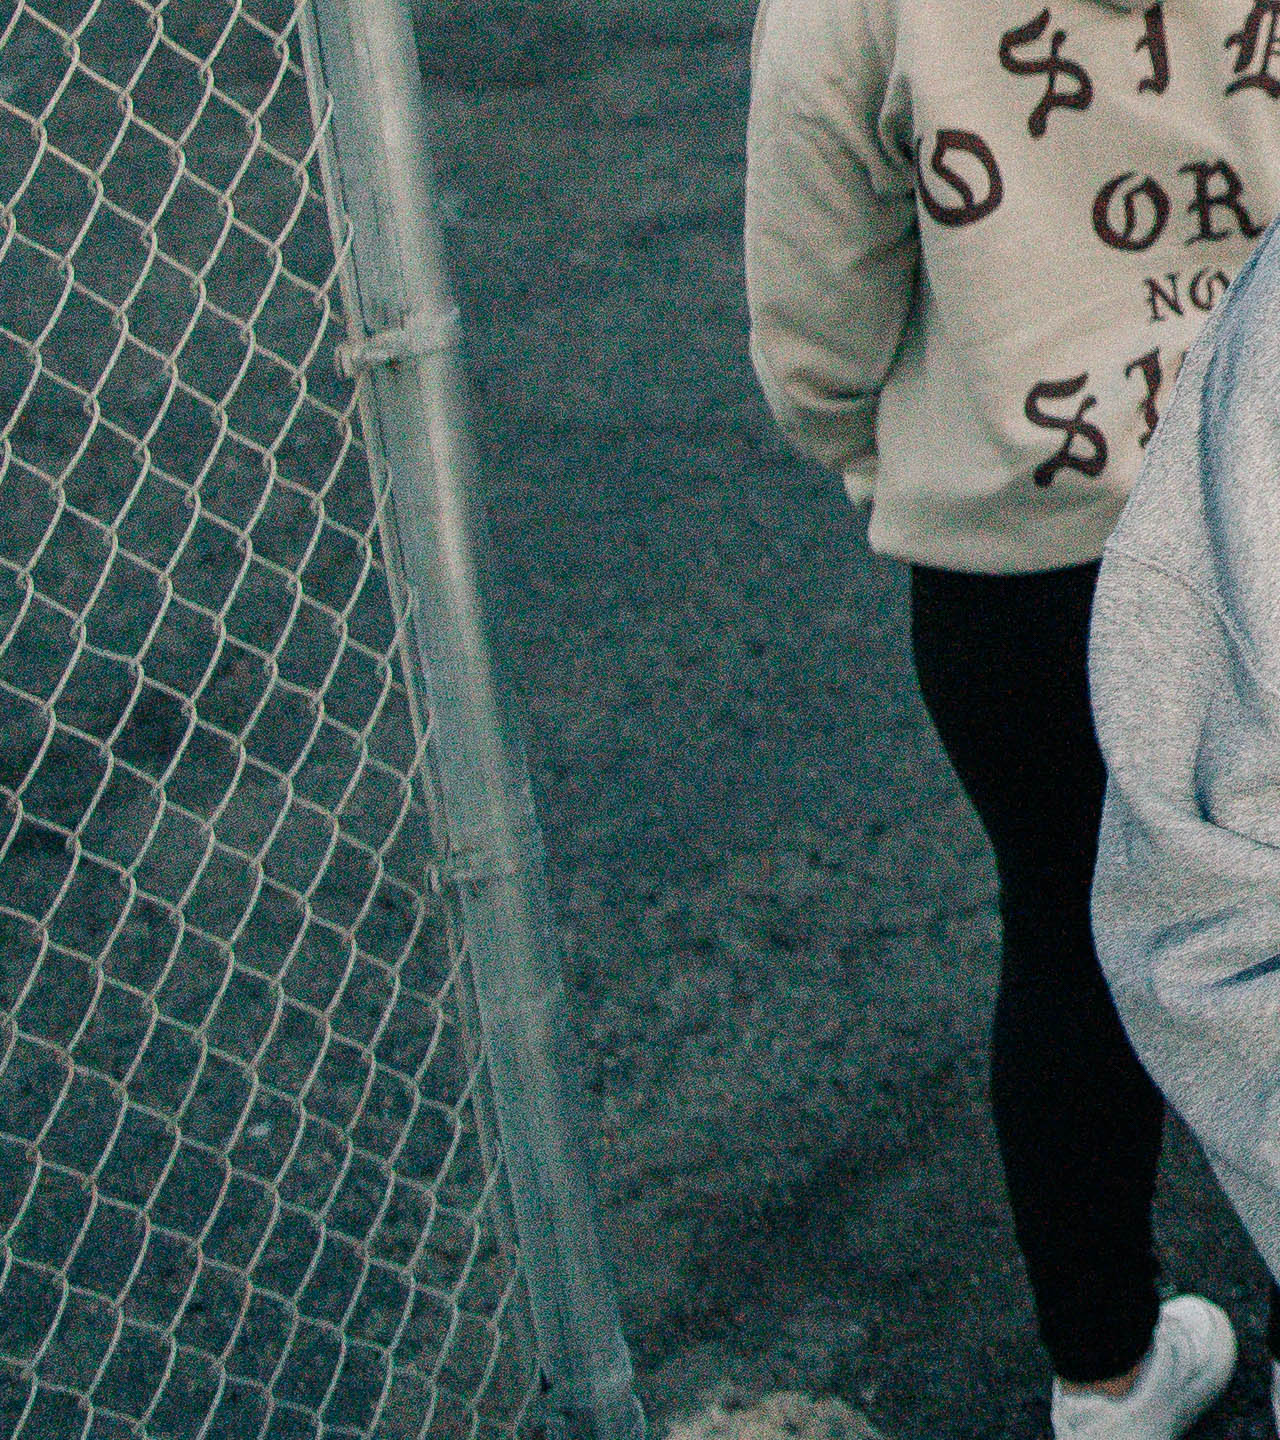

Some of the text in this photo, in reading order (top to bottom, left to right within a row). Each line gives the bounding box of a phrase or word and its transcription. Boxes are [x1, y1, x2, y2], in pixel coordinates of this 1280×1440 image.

[1092, 158, 1264, 252] OR
[1143, 269, 1231, 321] NO
[1023, 346, 1190, 488] SI
